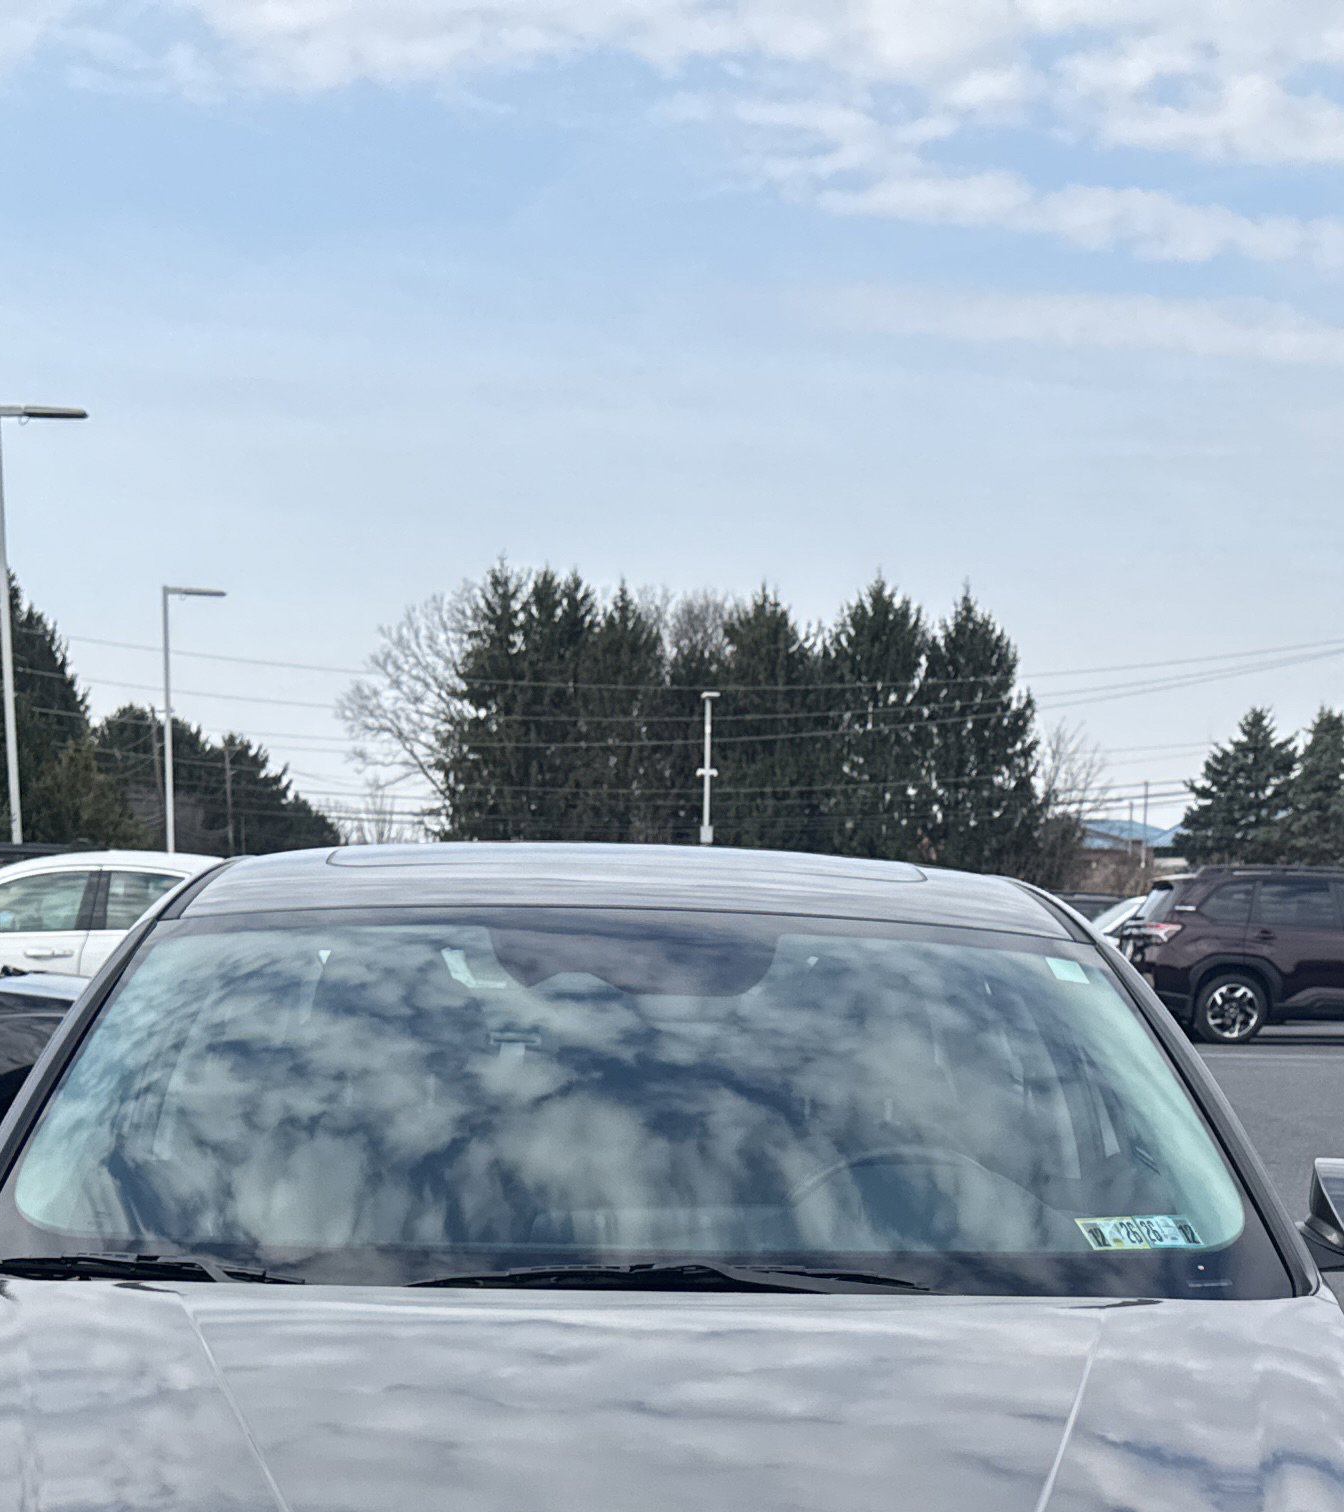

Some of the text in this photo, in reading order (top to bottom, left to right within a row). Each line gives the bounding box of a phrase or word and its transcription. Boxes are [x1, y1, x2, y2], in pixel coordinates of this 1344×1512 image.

[1087, 1221, 1143, 1247] 12 26
[1139, 1220, 1201, 1244] 26 12
